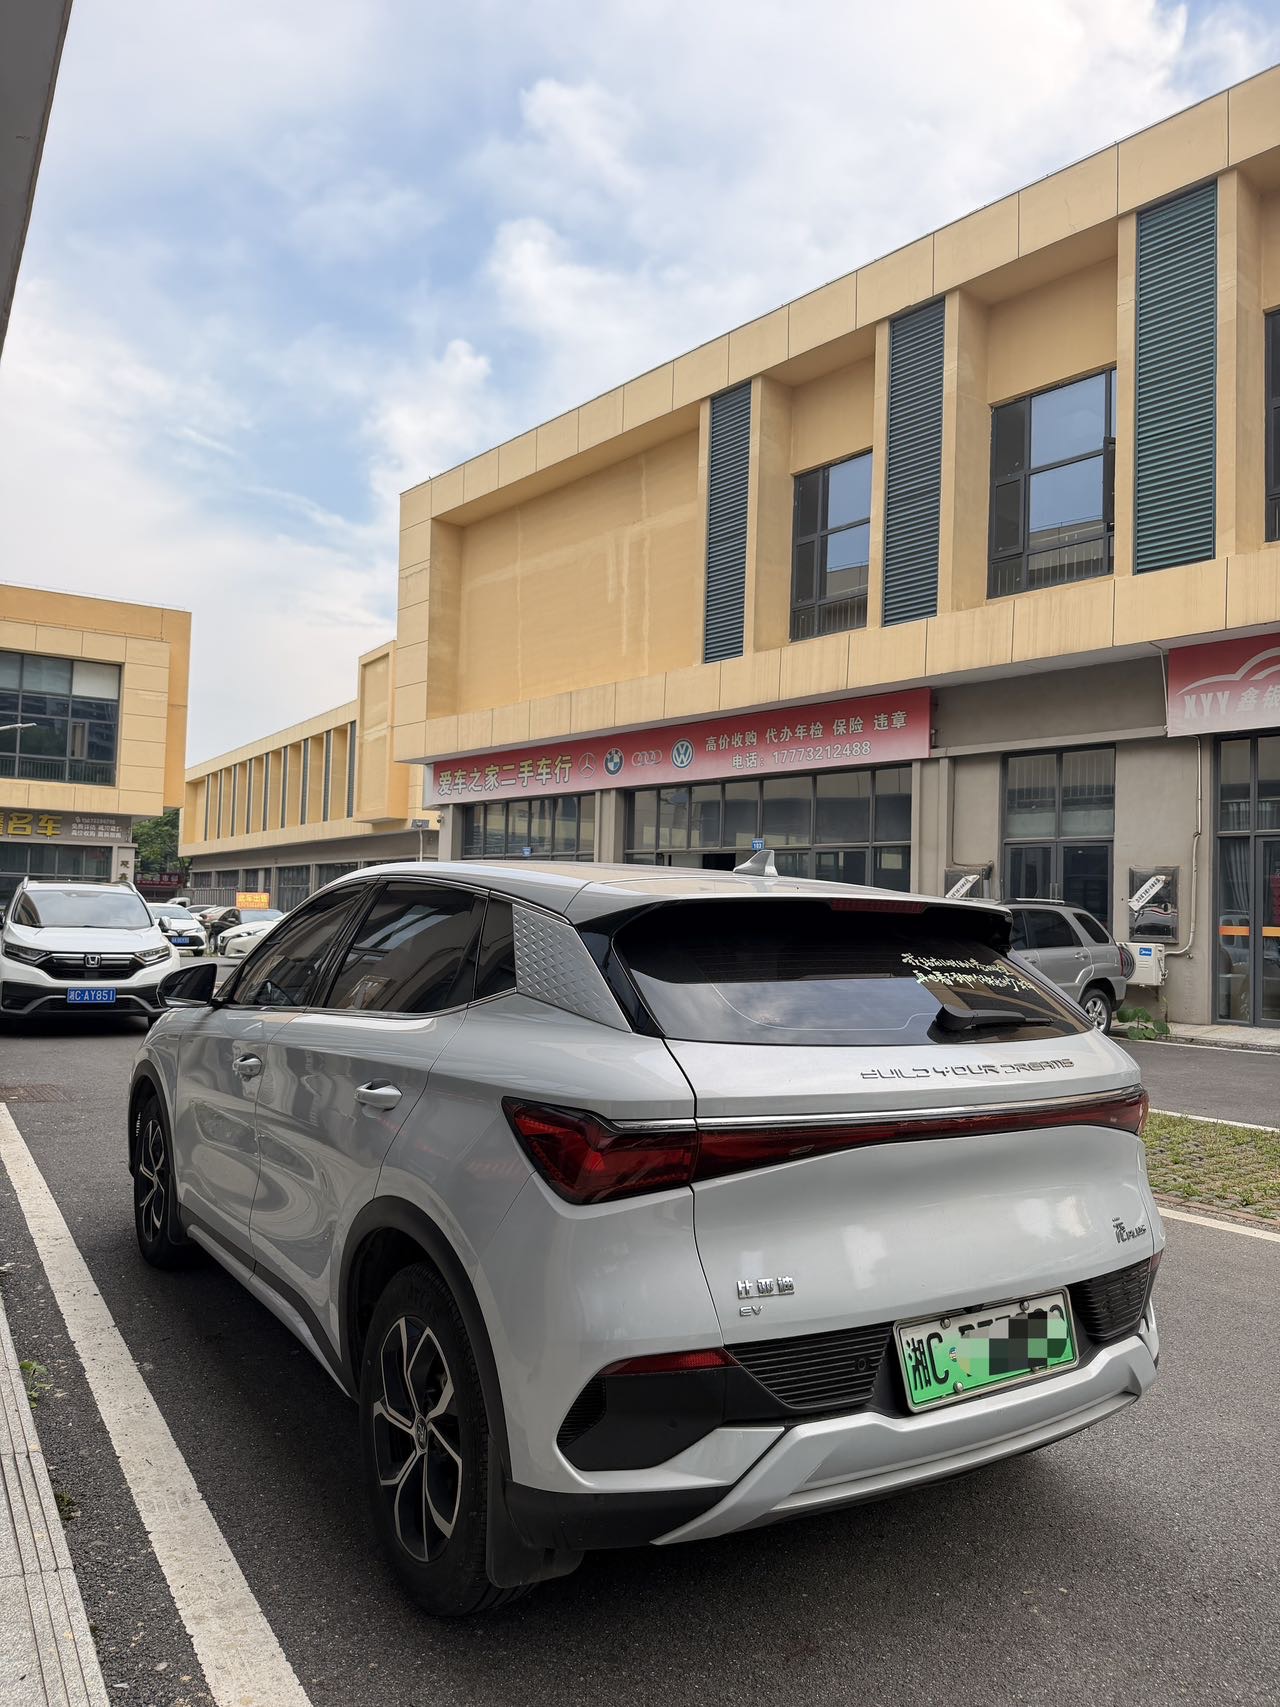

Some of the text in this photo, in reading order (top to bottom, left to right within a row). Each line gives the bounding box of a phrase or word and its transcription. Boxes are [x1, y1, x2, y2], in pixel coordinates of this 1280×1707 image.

[705, 711, 907, 752] 高价收购 代办年检 保险 违章
[773, 741, 872, 764] 17773212488
[438, 755, 572, 796] 爱车之家二手车行
[0, 812, 62, 837] 名车
[932, 1064, 1000, 1077] YOUR
[1000, 1058, 1075, 1074] DREAMS
[737, 1276, 795, 1300] 比亚迪
[740, 1305, 764, 1317] EV
